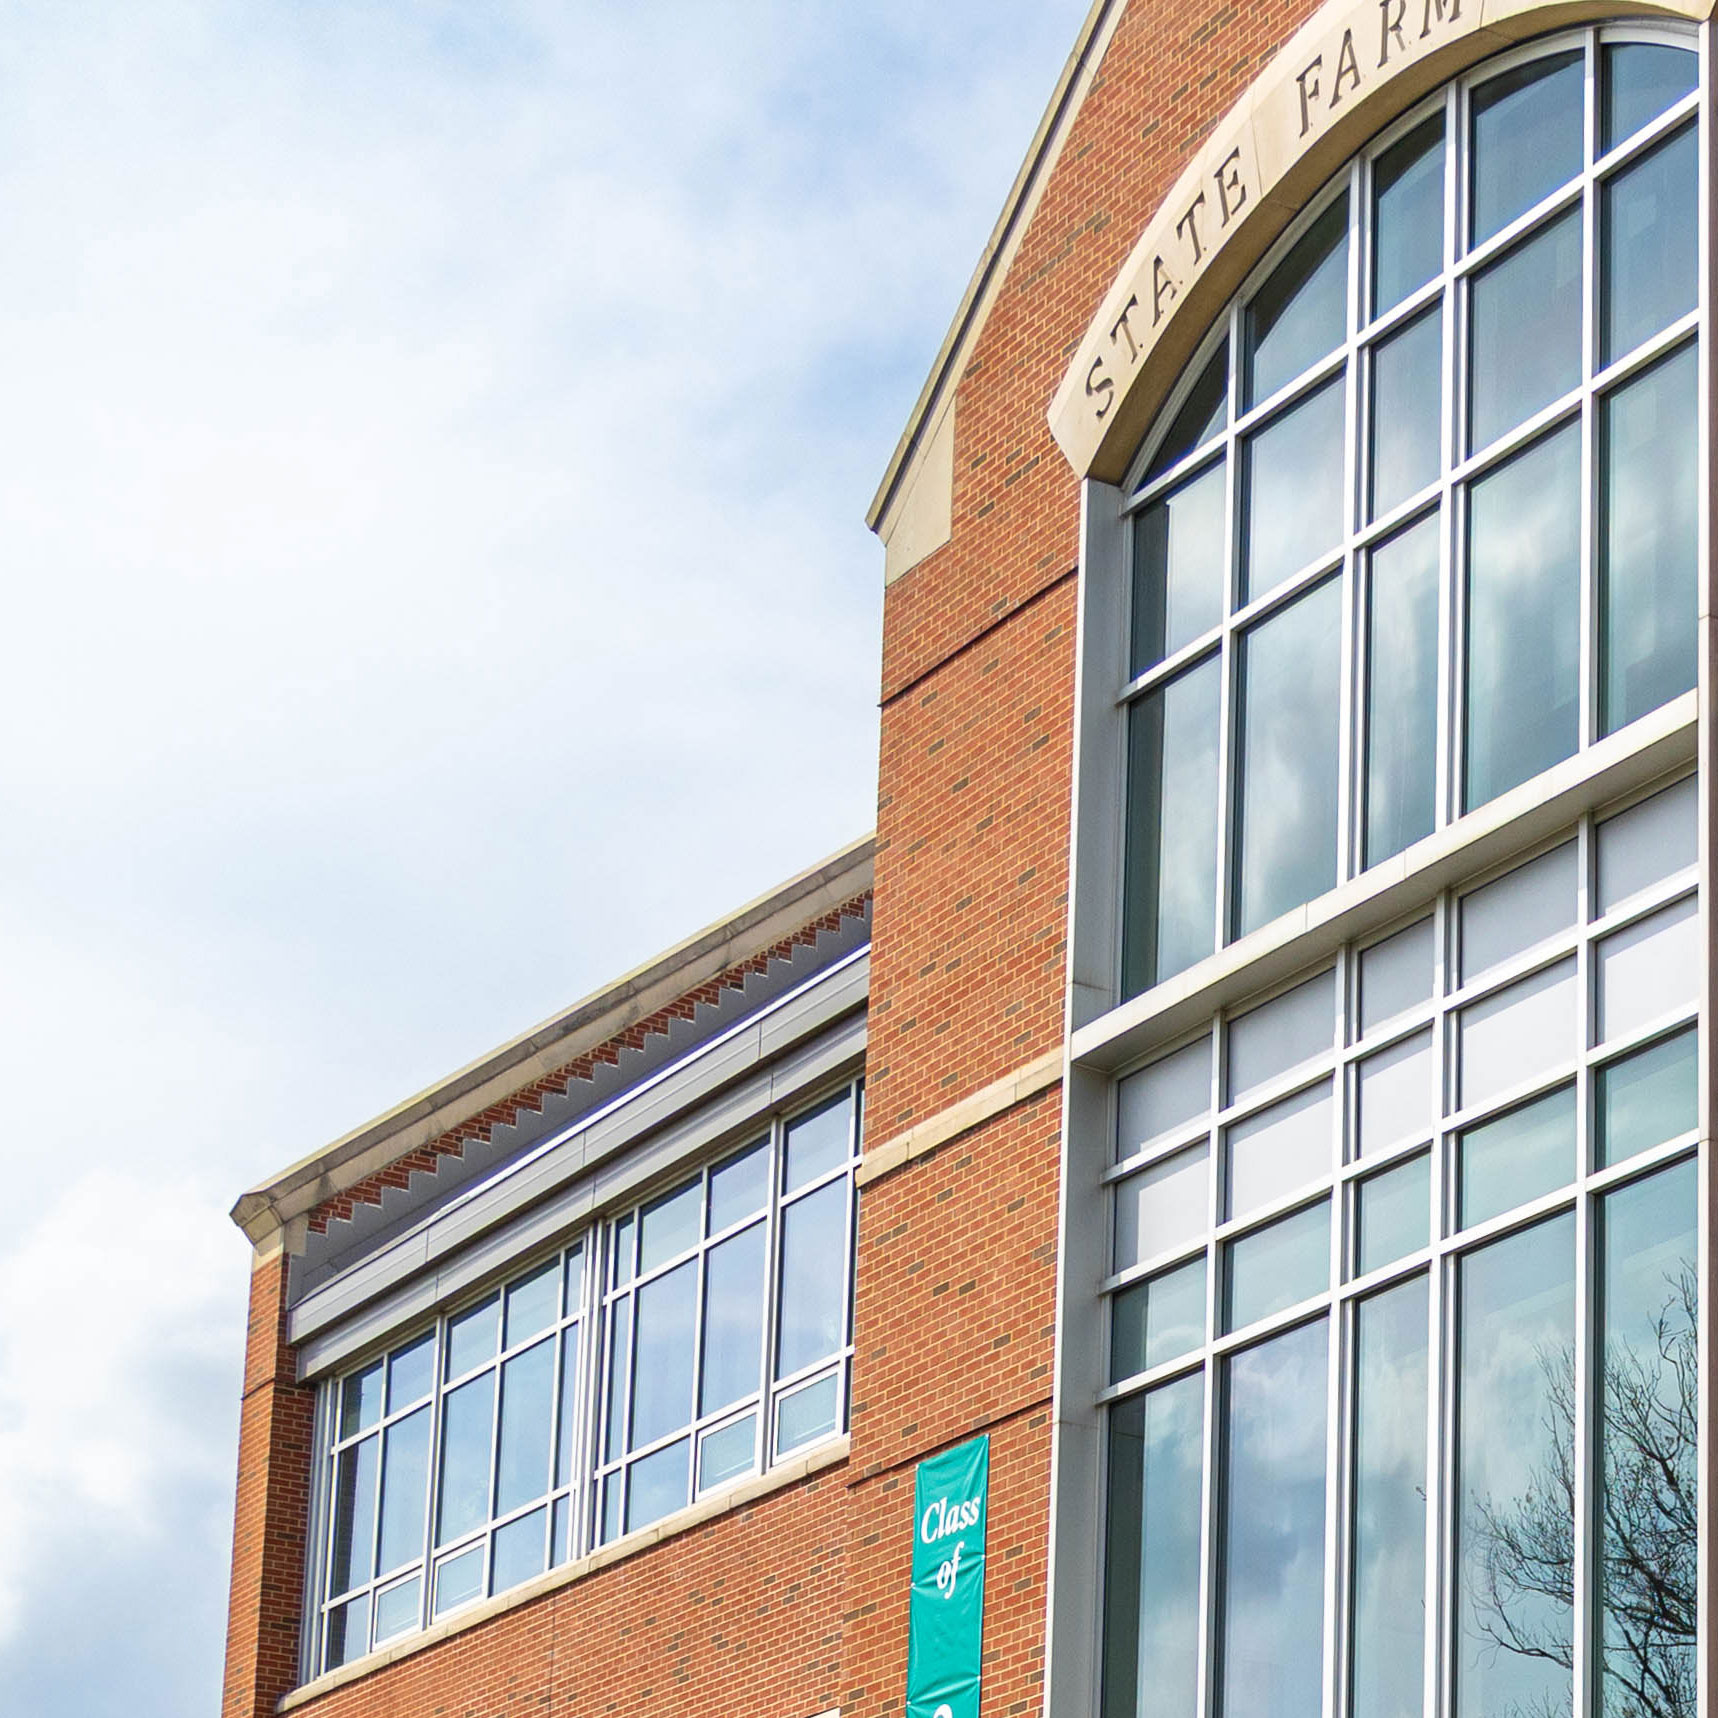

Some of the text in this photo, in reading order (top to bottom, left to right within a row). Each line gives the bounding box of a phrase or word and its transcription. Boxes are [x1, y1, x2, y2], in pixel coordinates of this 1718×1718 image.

[1085, 146, 1249, 421] STATE
[920, 1496, 982, 1544] Class
[936, 1541, 965, 1599] of
